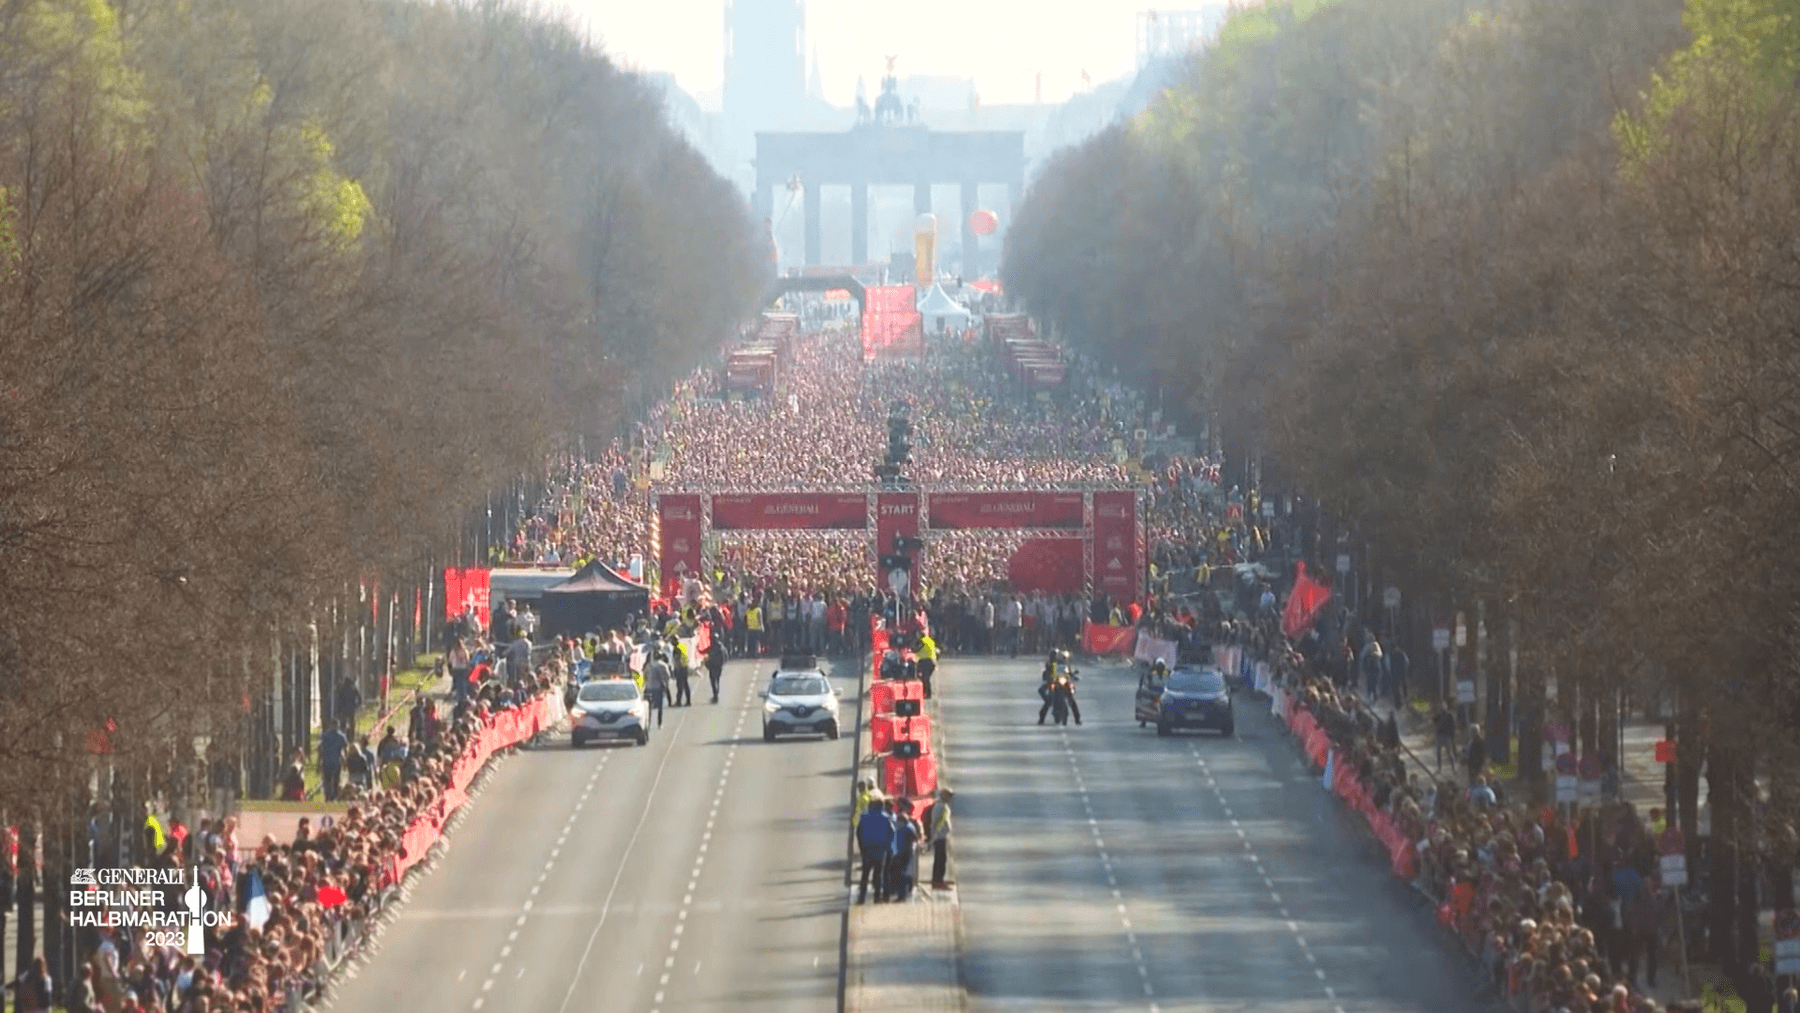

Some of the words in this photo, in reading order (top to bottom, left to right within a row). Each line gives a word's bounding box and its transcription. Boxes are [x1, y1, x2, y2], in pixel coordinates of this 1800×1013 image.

[776, 503, 819, 514] GENERALI
[880, 505, 915, 515] START
[992, 502, 1036, 513] GENERALI
